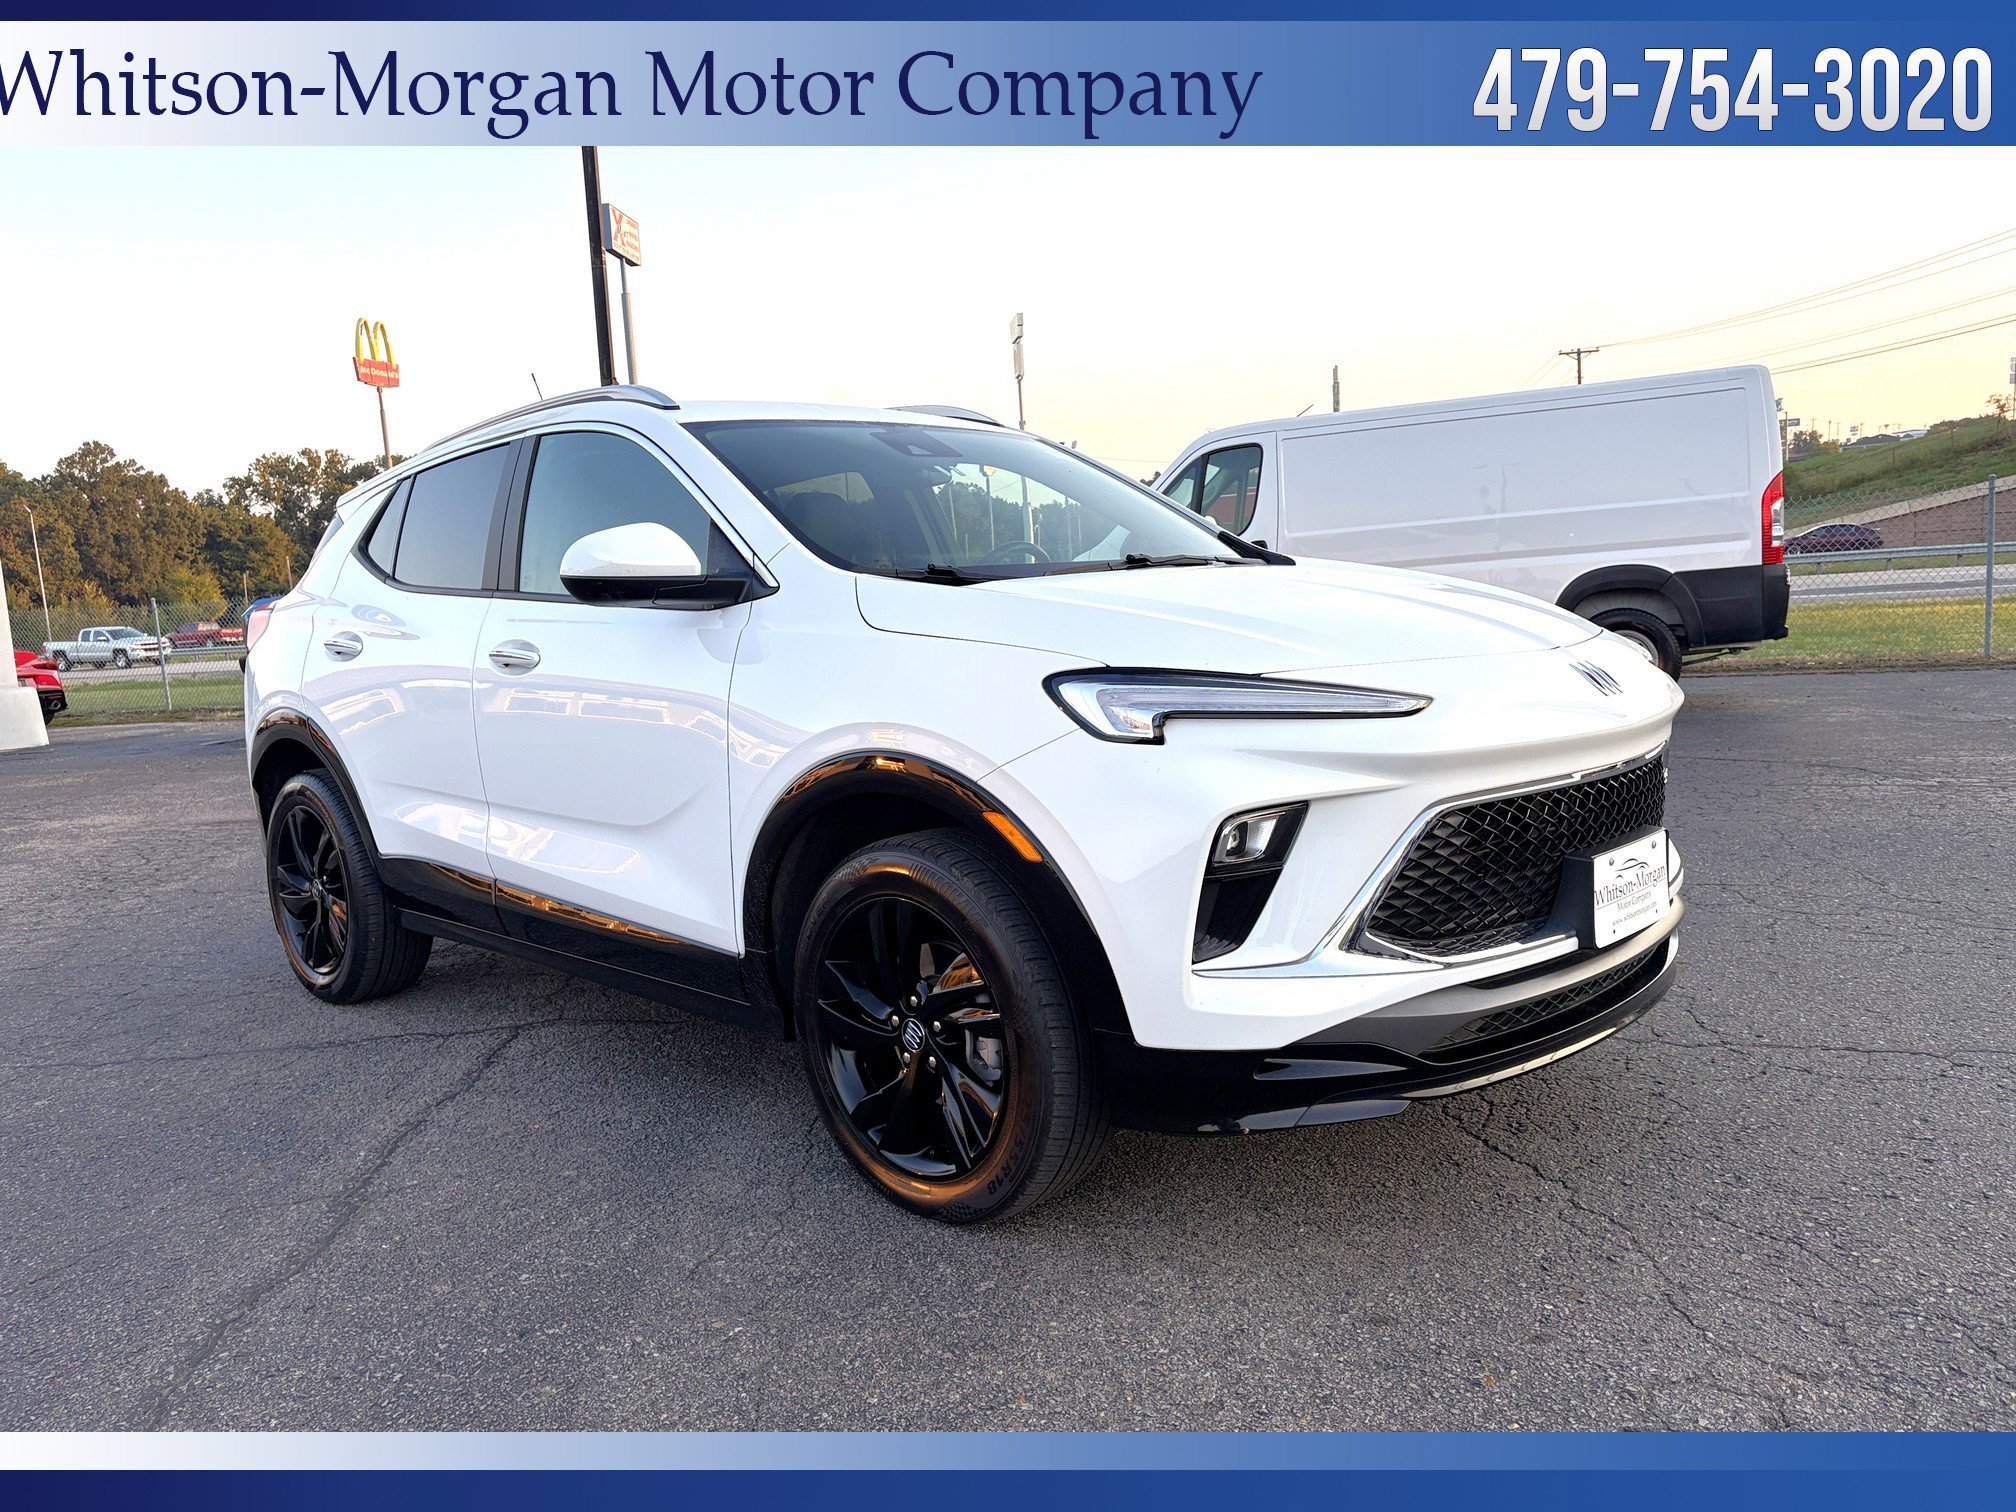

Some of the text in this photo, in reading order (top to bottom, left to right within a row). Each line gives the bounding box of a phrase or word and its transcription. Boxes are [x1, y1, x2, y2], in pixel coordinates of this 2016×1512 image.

[1594, 865, 1666, 906] Whitson-Morgan
[1616, 890, 1652, 911] Motor Company
